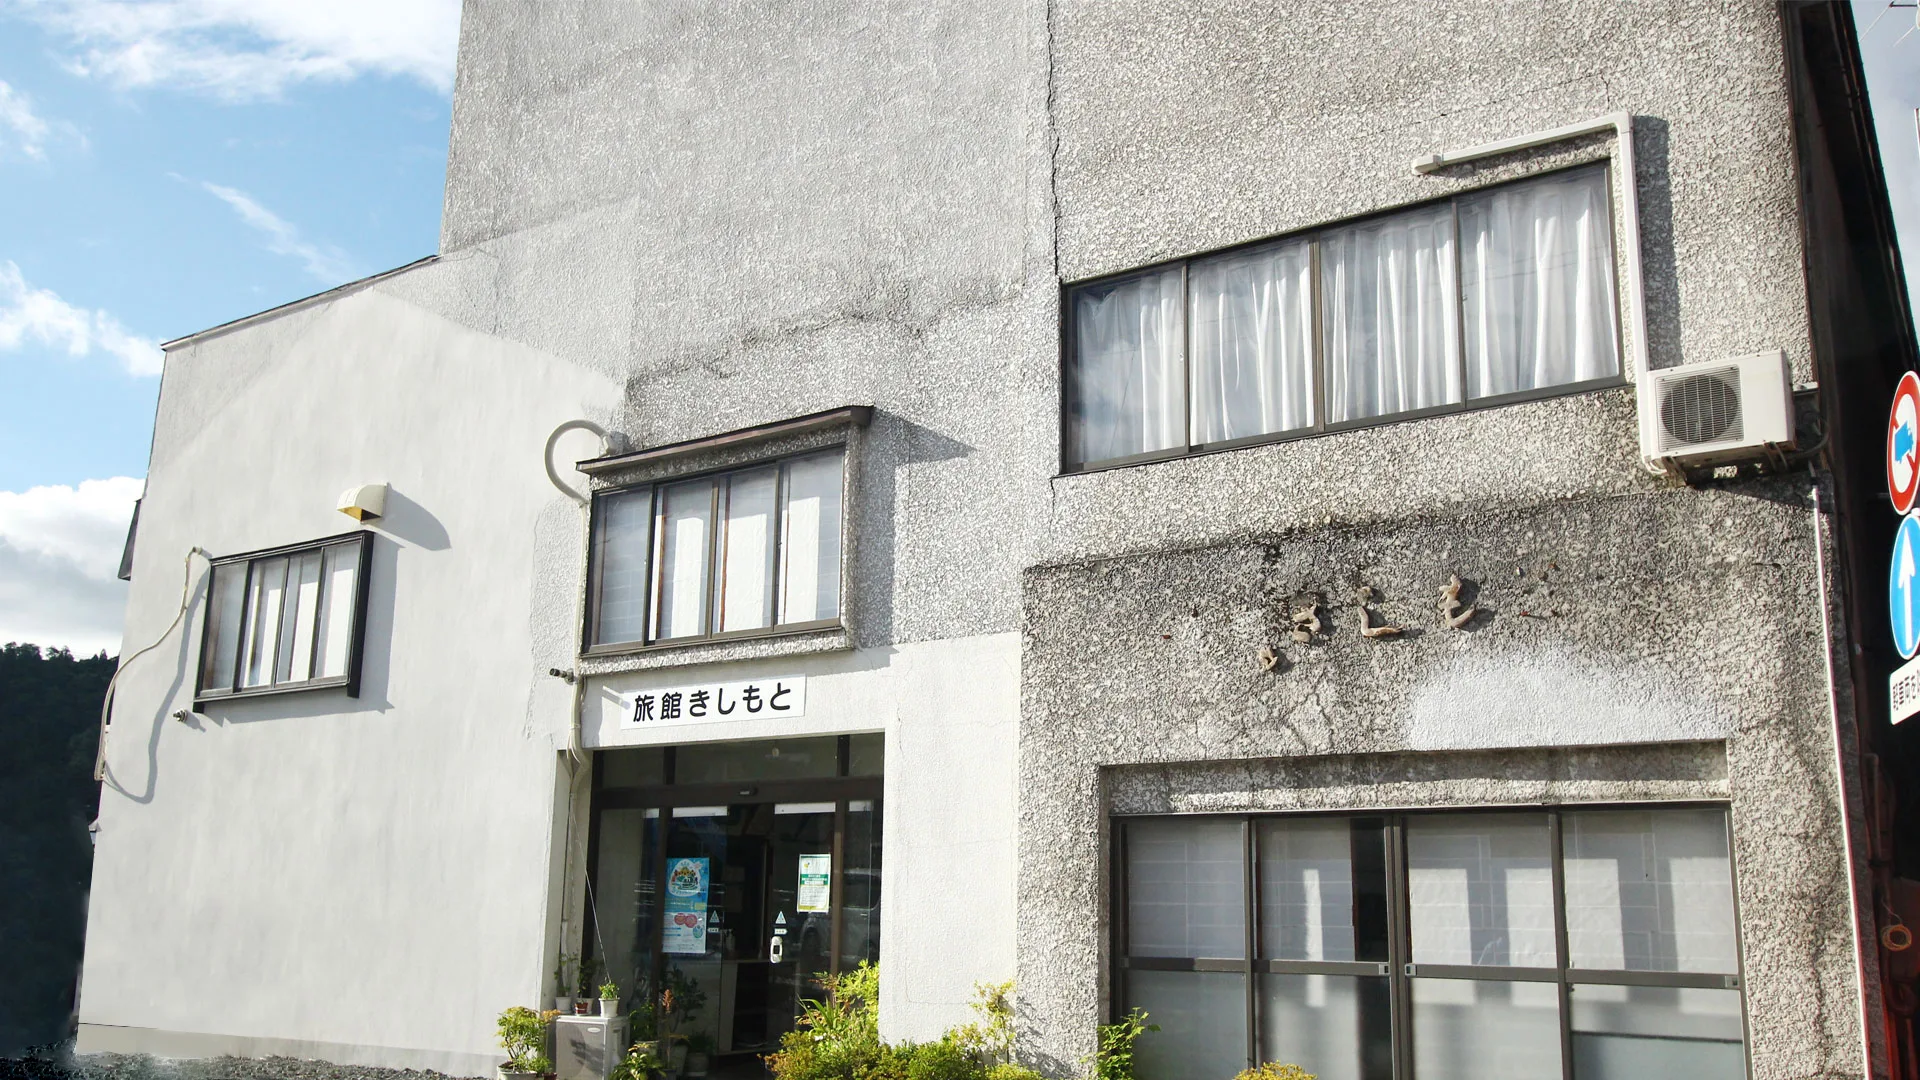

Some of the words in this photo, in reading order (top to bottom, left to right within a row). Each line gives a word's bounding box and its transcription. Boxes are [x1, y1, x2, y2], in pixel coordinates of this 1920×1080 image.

[632, 681, 792, 722] 旅館きしもと
